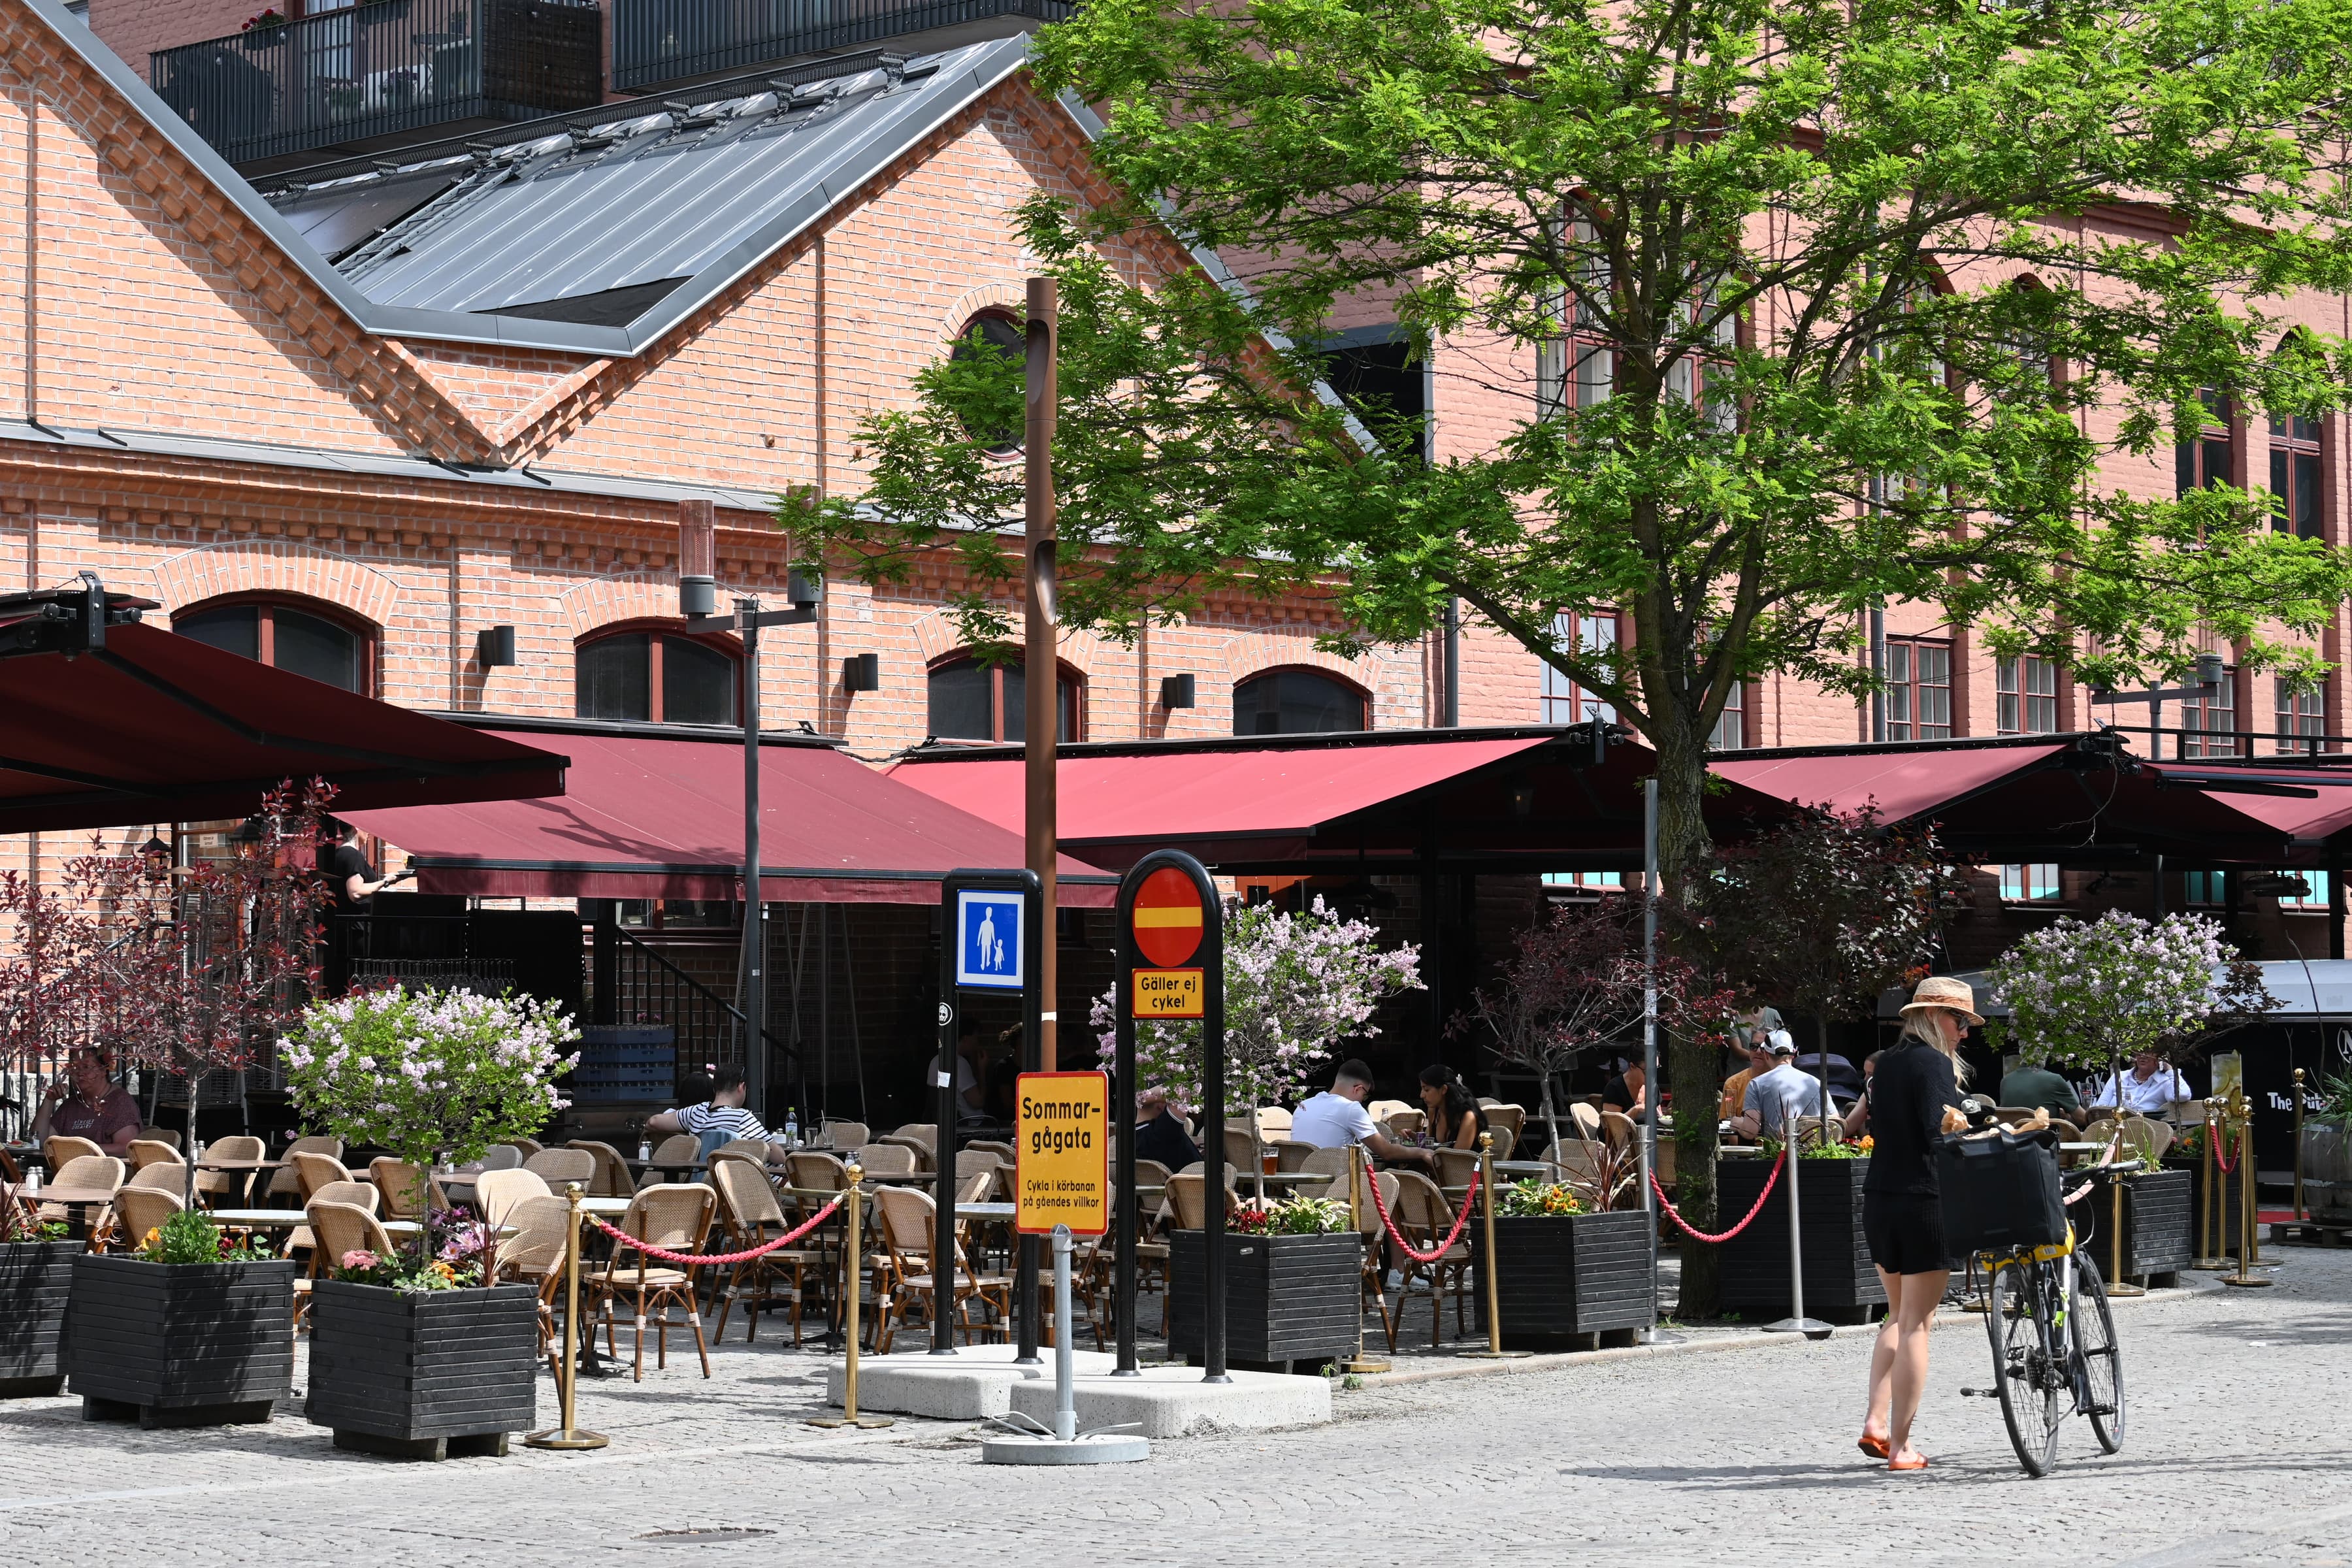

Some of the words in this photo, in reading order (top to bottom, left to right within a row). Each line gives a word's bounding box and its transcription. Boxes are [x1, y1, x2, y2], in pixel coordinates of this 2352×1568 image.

[1141, 977, 1179, 990] Gäller
[1184, 976, 1196, 993] ej
[1152, 994, 1184, 1011] cykel
[1022, 1097, 1100, 1119] Sommar-
[2267, 1092, 2293, 1111] The
[1032, 1126, 1090, 1154] gågata
[1027, 1180, 1049, 1193] Cykla
[1052, 1180, 1054, 1191] i
[1056, 1180, 1096, 1191] körbanan
[1023, 1196, 1034, 1209] på
[1036, 1196, 1071, 1209] gåendes
[1073, 1196, 1100, 1207] villkor
